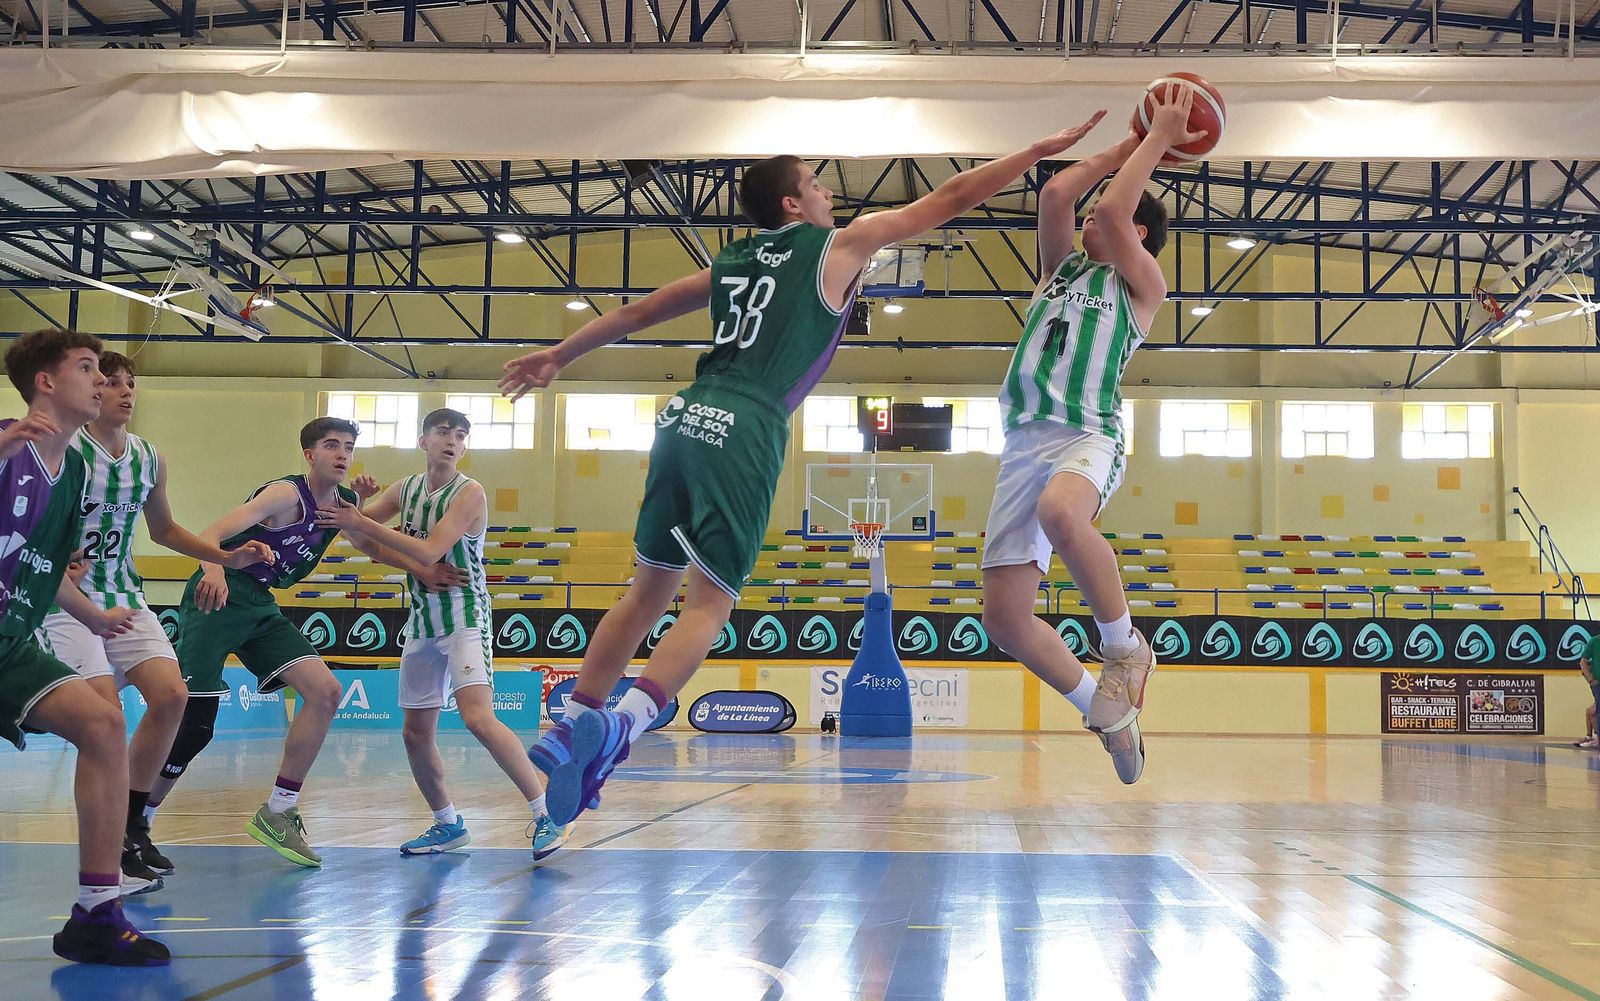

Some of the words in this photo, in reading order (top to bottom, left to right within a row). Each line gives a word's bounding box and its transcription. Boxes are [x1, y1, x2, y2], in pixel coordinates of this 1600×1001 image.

[1064, 291, 1114, 311] yTicket
[714, 275, 776, 350] 38
[687, 402, 736, 426] COSTA
[877, 409, 888, 430] 9
[681, 412, 701, 427] DEL
[701, 419, 729, 438] SOL
[676, 424, 723, 449] MÁLAGA
[102, 503, 144, 513] XoyTick
[83, 530, 121, 560] 22
[1478, 679, 1489, 688] DE
[1491, 679, 1536, 688] GIBRALTAR
[493, 691, 527, 701] ncesto
[493, 702, 523, 711] alucía
[711, 703, 780, 713] Ayuntamiento
[1391, 705, 1457, 716] RESTAURANTE
[341, 711, 352, 719] de
[352, 711, 390, 719] Andalucía
[716, 713, 729, 721] de
[729, 713, 743, 721] La
[1469, 714, 1534, 723] CELEBRACIONES
[1391, 718, 1427, 728] BUFFET
[1429, 718, 1457, 729] LIBRE
